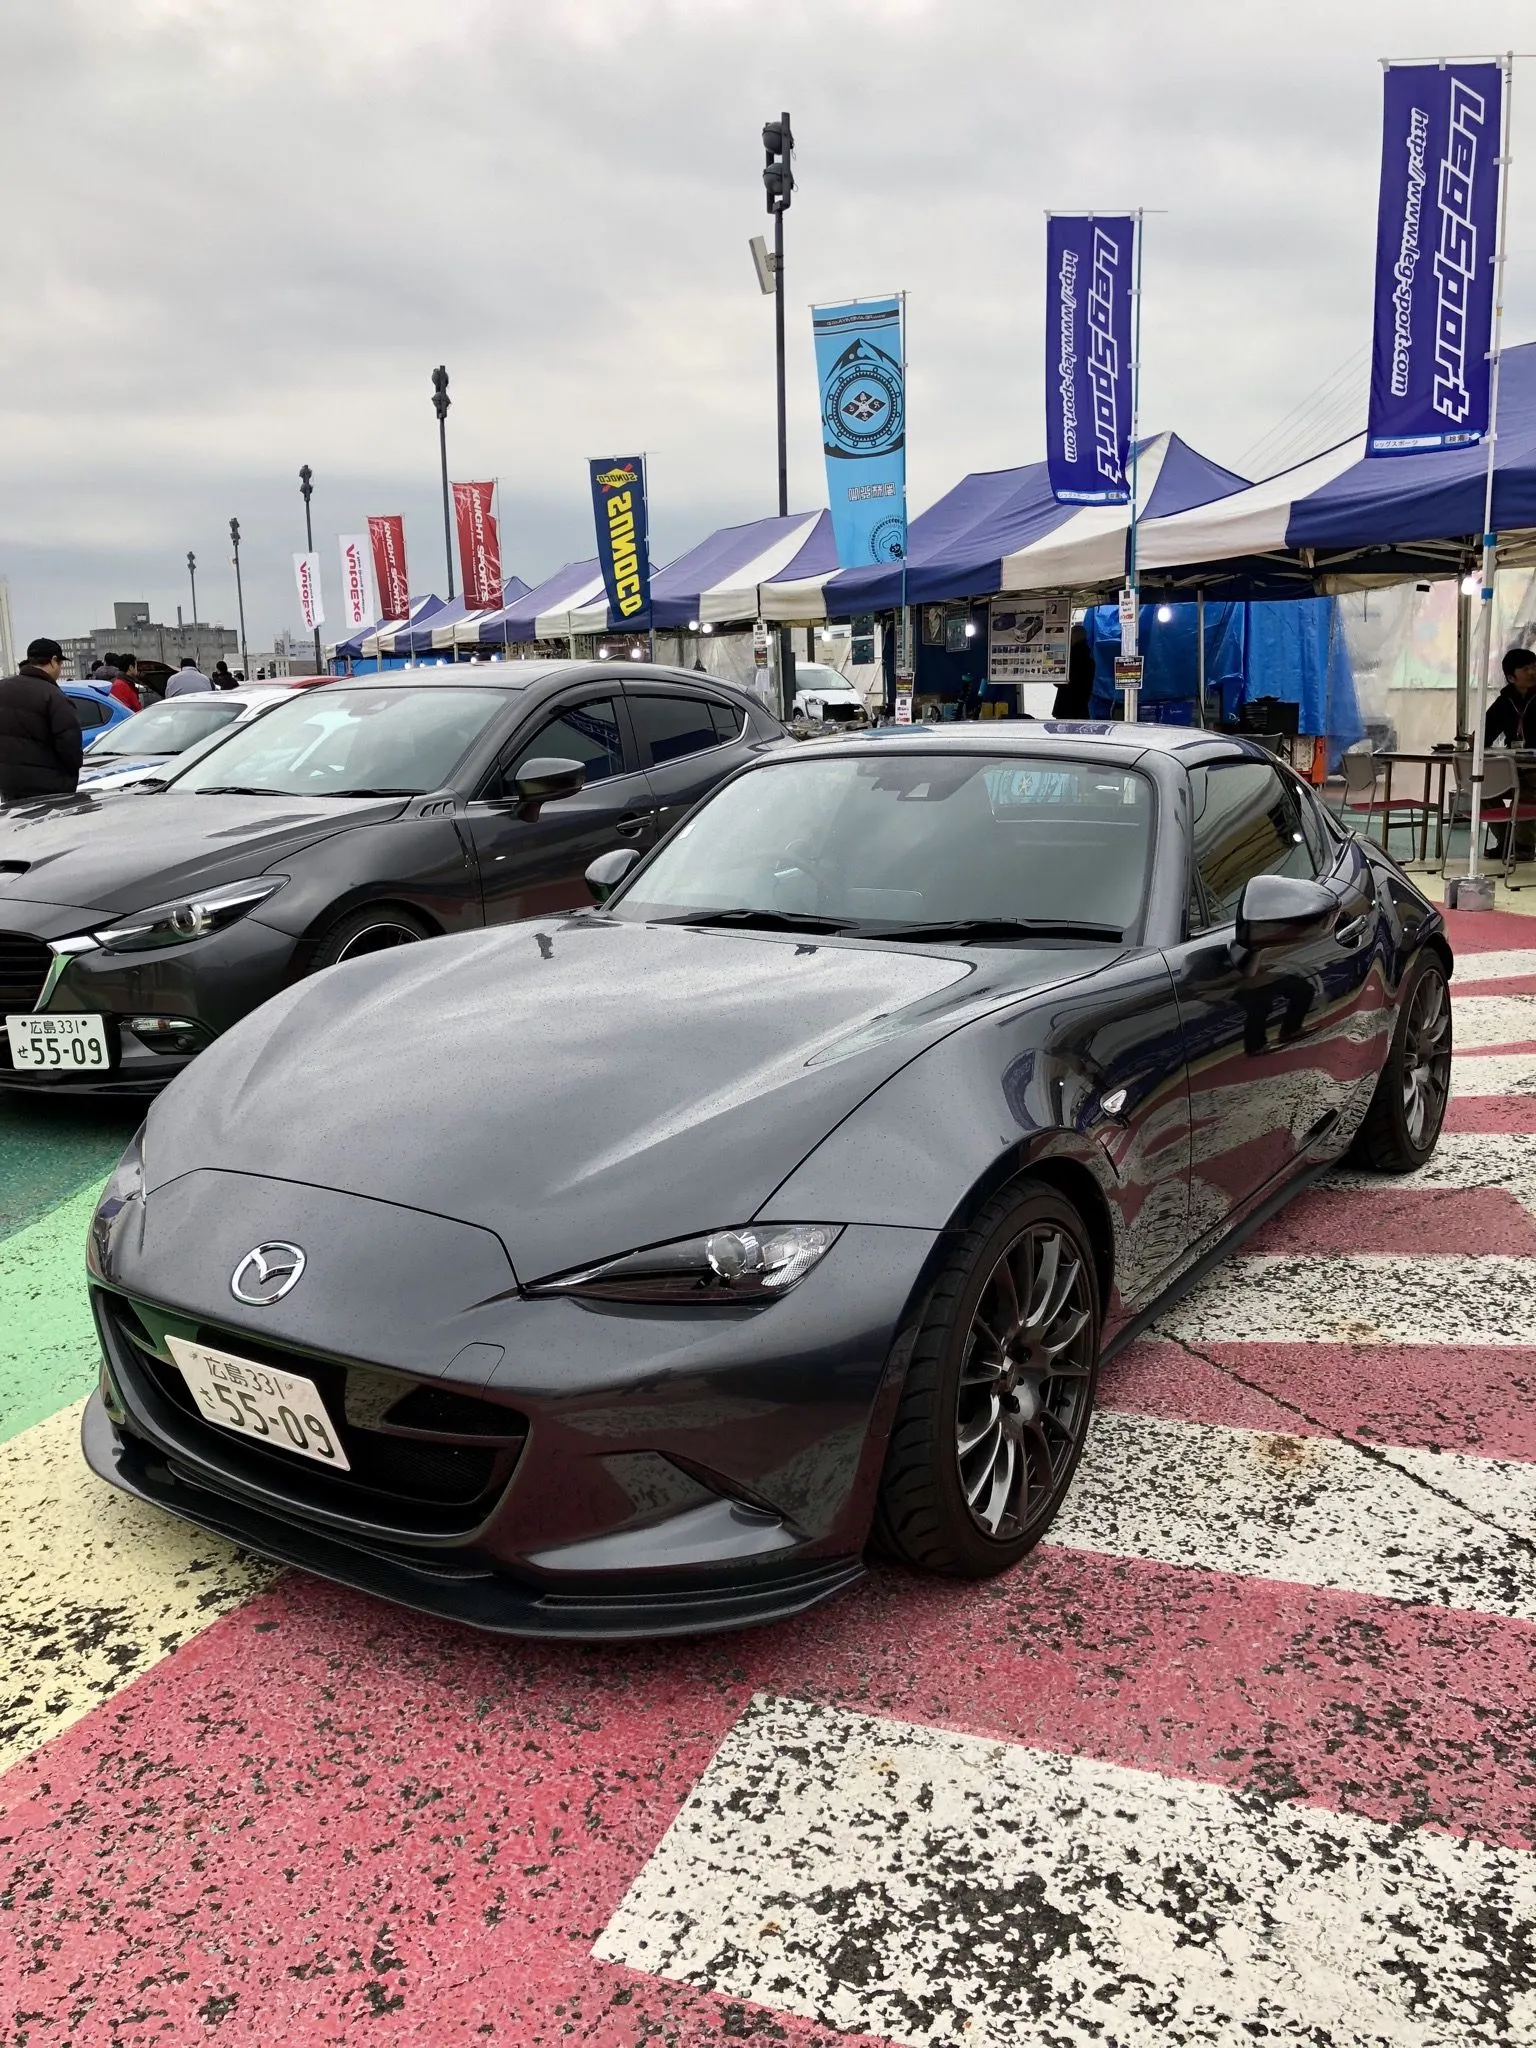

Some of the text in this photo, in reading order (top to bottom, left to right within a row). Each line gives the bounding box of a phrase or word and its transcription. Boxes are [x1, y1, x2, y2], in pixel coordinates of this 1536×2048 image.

[1391, 106, 1429, 398] http://www.leg-sport.com
[1433, 77, 1485, 424] LegSport
[1061, 249, 1080, 464] http://www.leg-sport.com
[1087, 226, 1122, 484] LegSport
[472, 488, 484, 540] KNIGHT
[383, 521, 395, 566] KNIGHT
[391, 567, 401, 615] SPORTS
[476, 545, 489, 602] SPORTS
[17, 1037, 102, 1065] せ 55-09
[213, 1382, 335, 1459] 55-09
